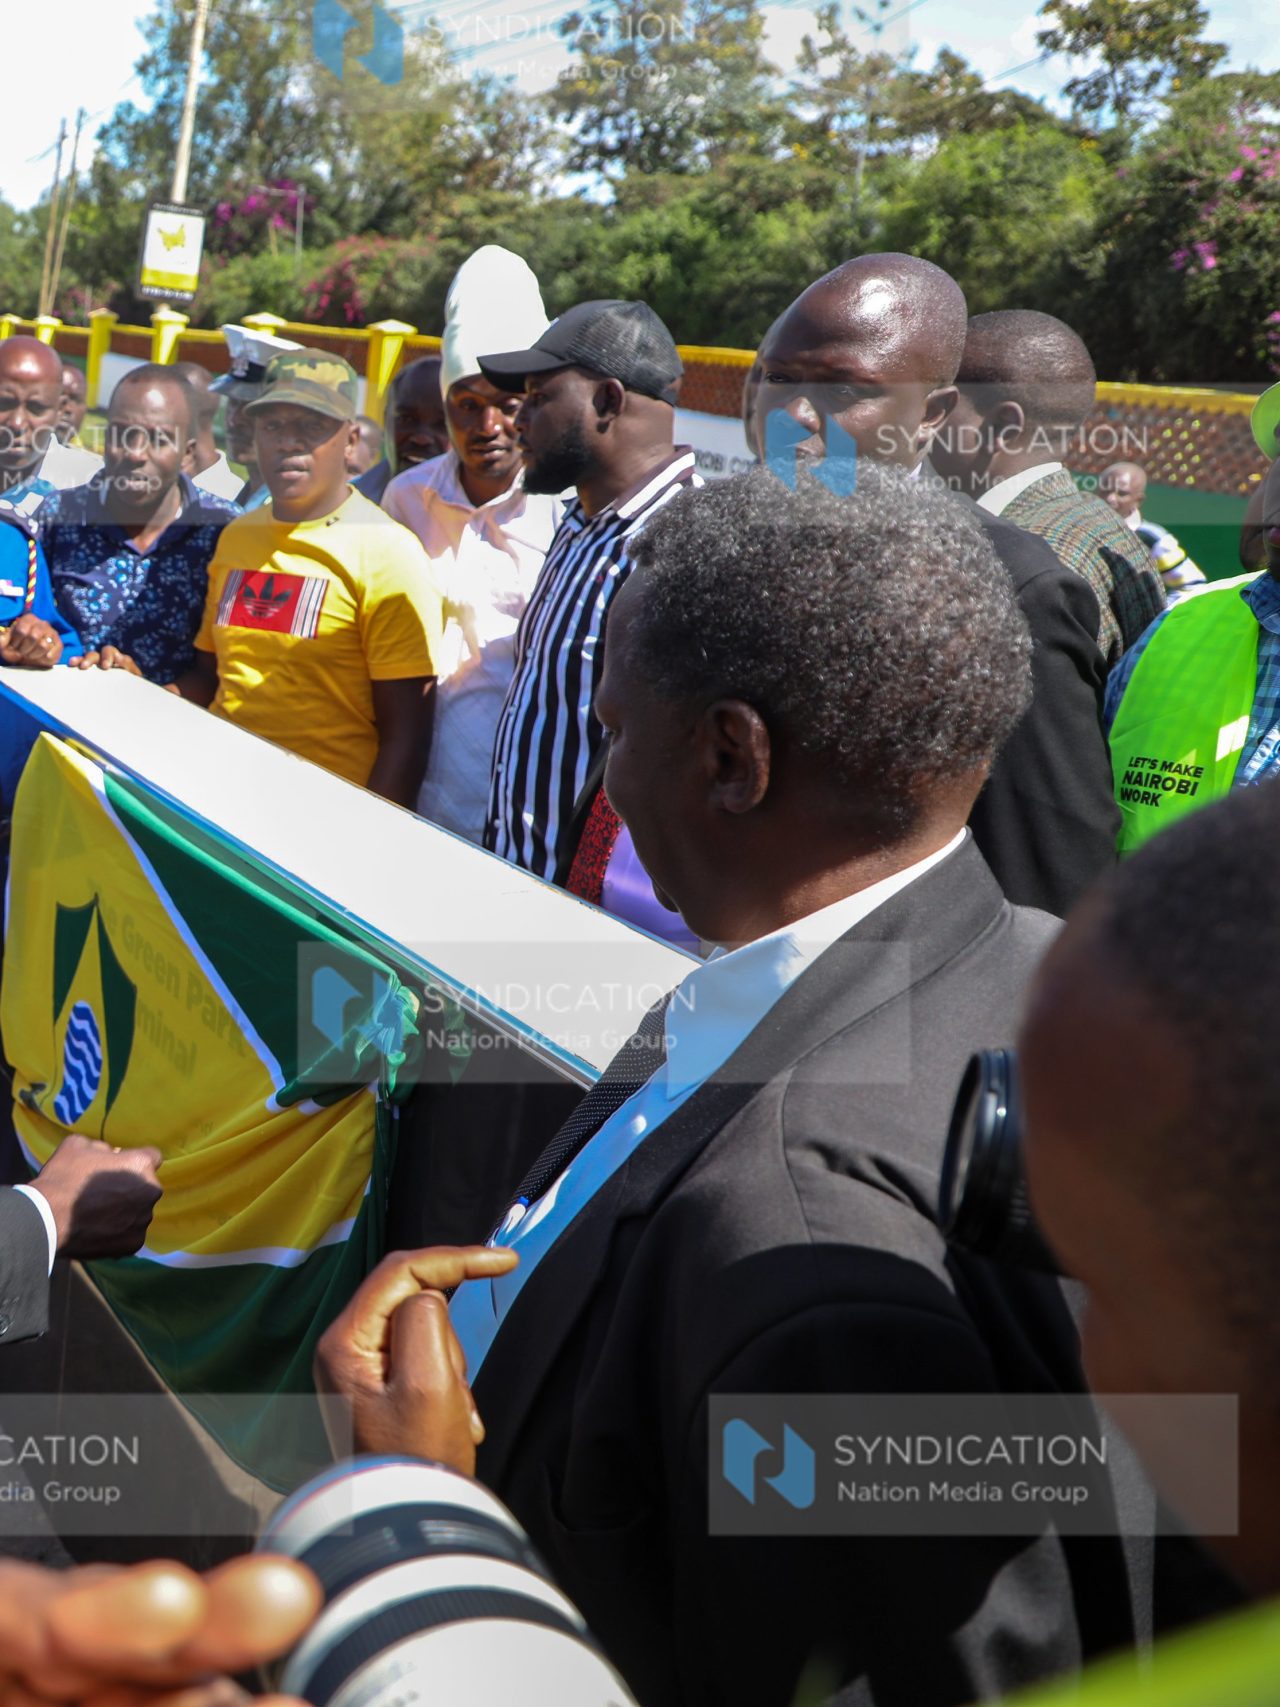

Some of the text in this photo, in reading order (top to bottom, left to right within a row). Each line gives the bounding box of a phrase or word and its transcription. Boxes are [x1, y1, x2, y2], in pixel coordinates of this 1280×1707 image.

[1128, 757, 1204, 778] LET'S MAKE
[1122, 771, 1199, 796] NAIROBI
[1121, 787, 1162, 807] WORK
[121, 914, 180, 999] Green
[136, 998, 198, 1079] minal
